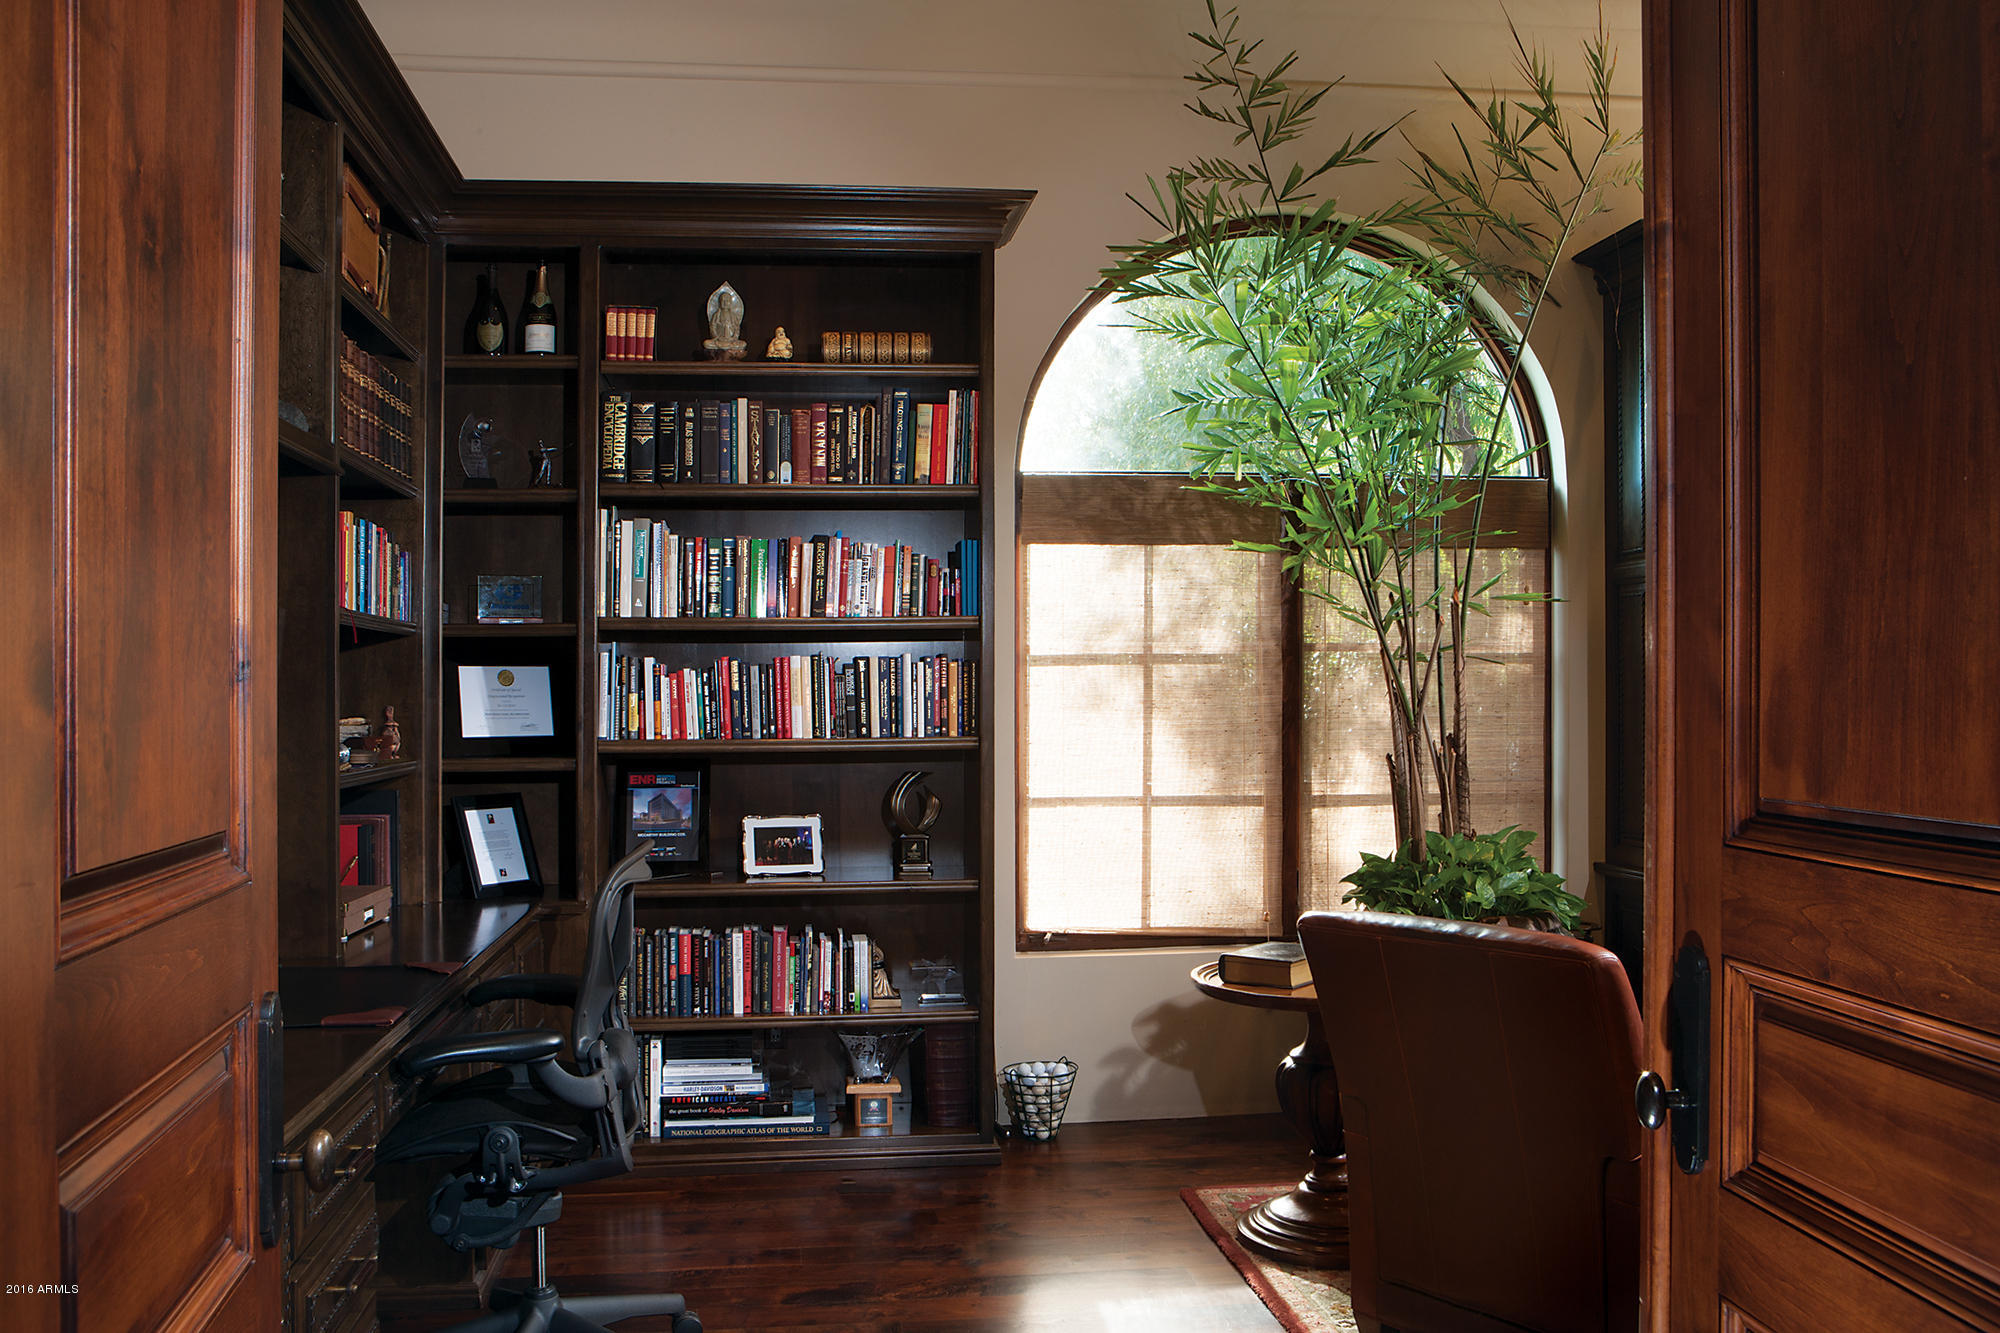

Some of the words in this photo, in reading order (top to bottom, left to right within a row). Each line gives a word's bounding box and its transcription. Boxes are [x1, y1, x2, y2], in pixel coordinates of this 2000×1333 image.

[896, 400, 904, 431] PILOTING
[602, 402, 614, 470] ENCYCLOPEDIA
[613, 402, 627, 470] CAMBRIDGE
[685, 421, 694, 437] ATLAS
[813, 421, 826, 437] SEA
[684, 438, 693, 466] SHRUGGED
[813, 439, 826, 448] AT
[813, 449, 826, 467] MEN
[757, 548, 766, 578] Personal
[630, 775, 656, 784] ENR
